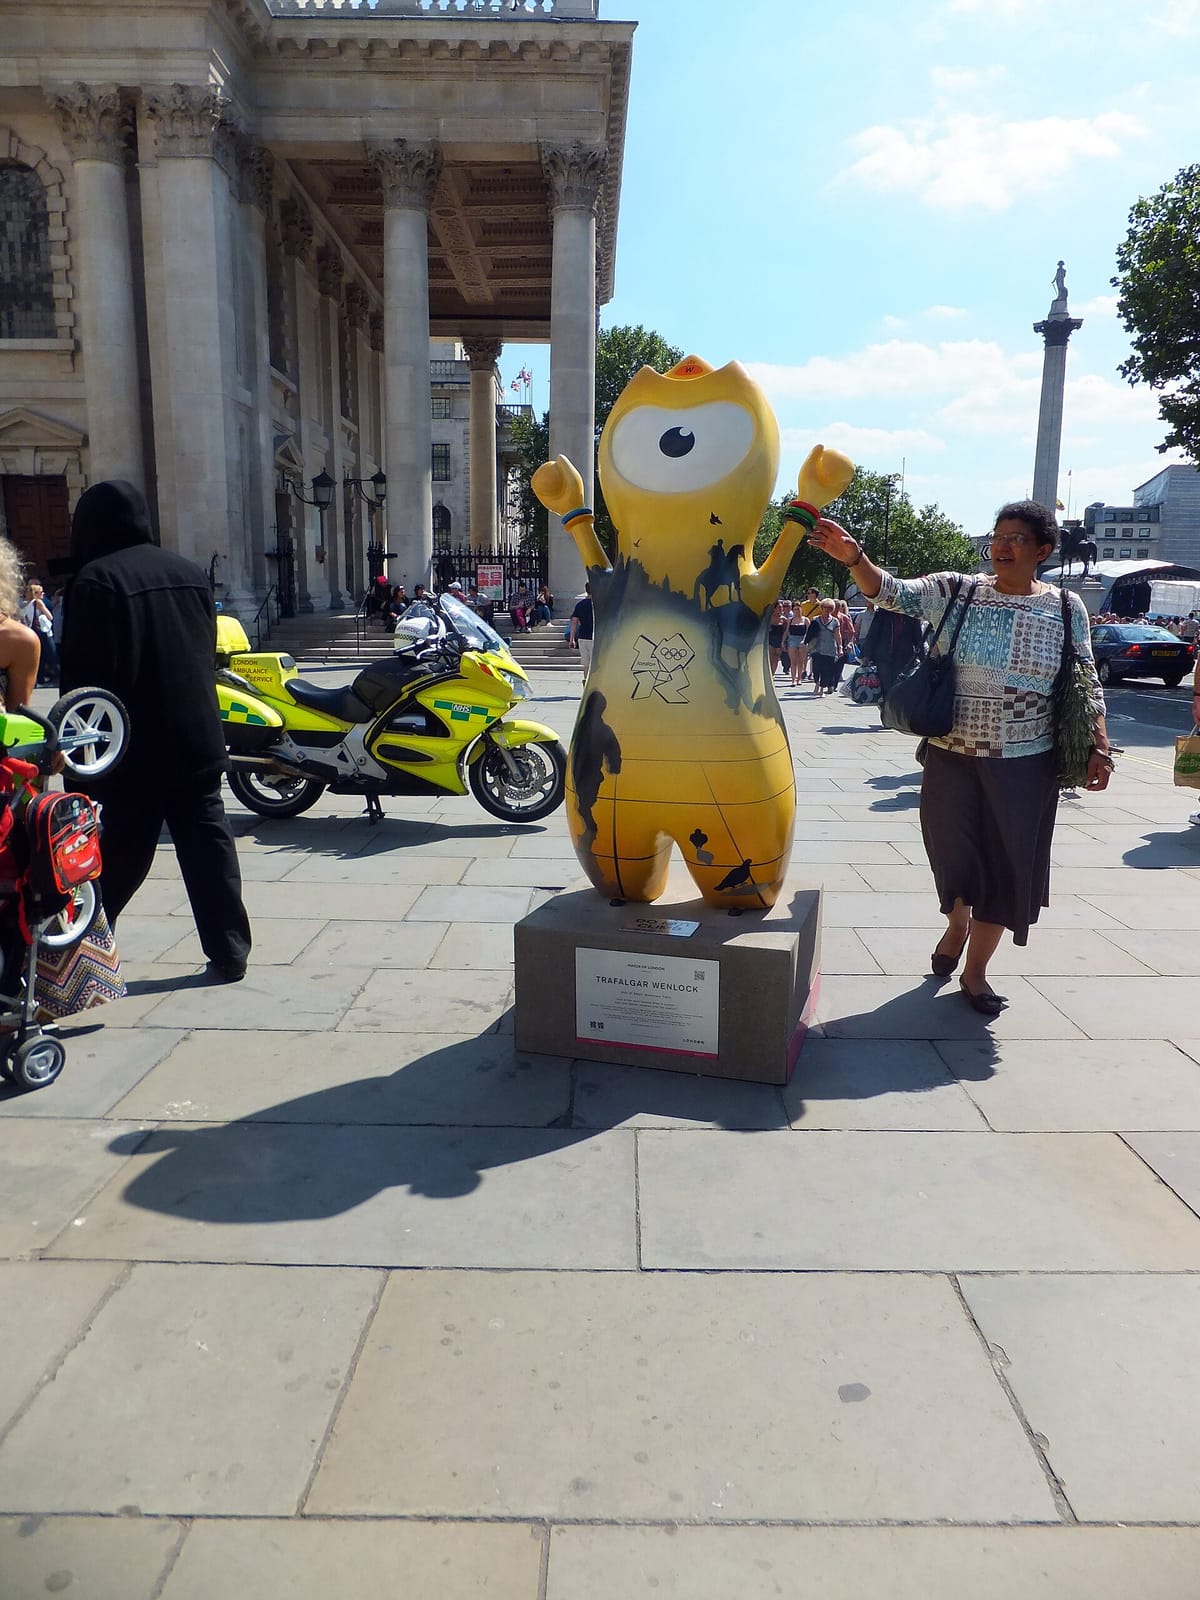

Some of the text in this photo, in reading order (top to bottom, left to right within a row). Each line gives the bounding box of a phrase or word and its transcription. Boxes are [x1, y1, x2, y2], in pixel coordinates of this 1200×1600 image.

[453, 704, 470, 712] NHS
[596, 975, 698, 993] TRAFALGAR WENLOCK
